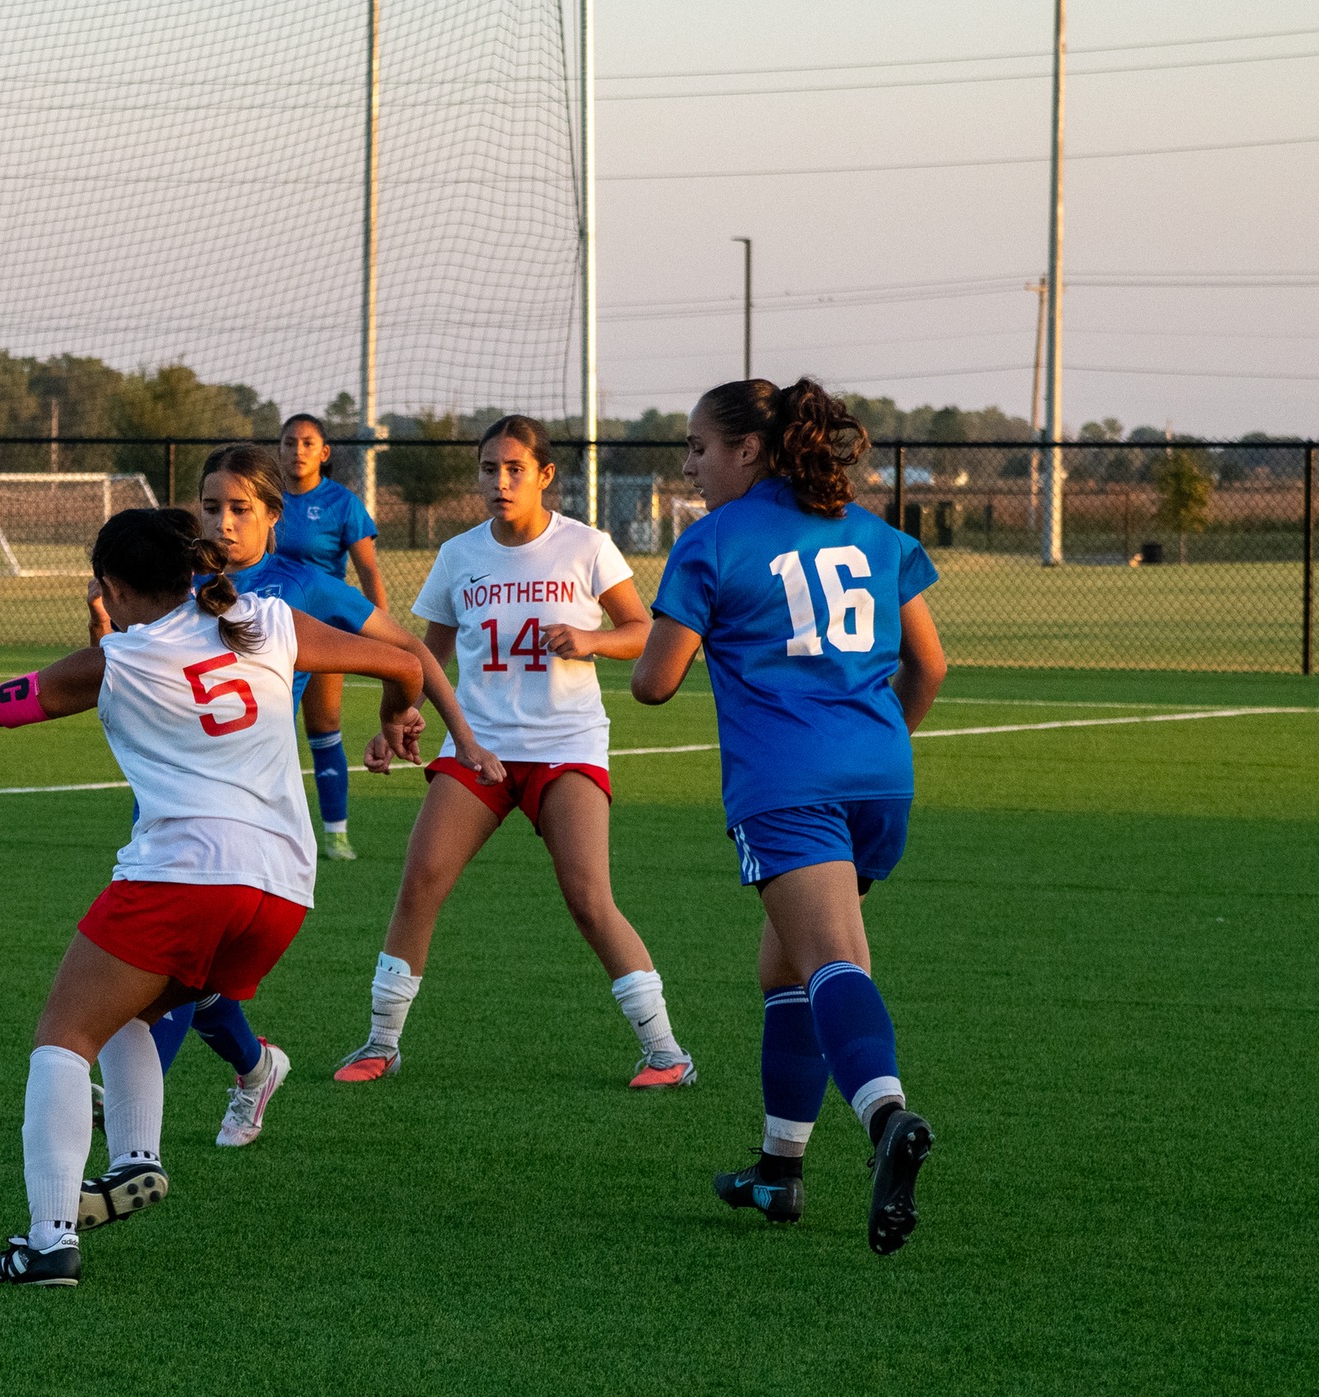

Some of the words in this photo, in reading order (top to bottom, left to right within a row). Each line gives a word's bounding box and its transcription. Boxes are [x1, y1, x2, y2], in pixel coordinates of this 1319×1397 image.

[462, 581, 575, 611] NORTHERN
[769, 545, 875, 657] 16
[480, 617, 547, 672] 14
[182, 651, 258, 737] 5
